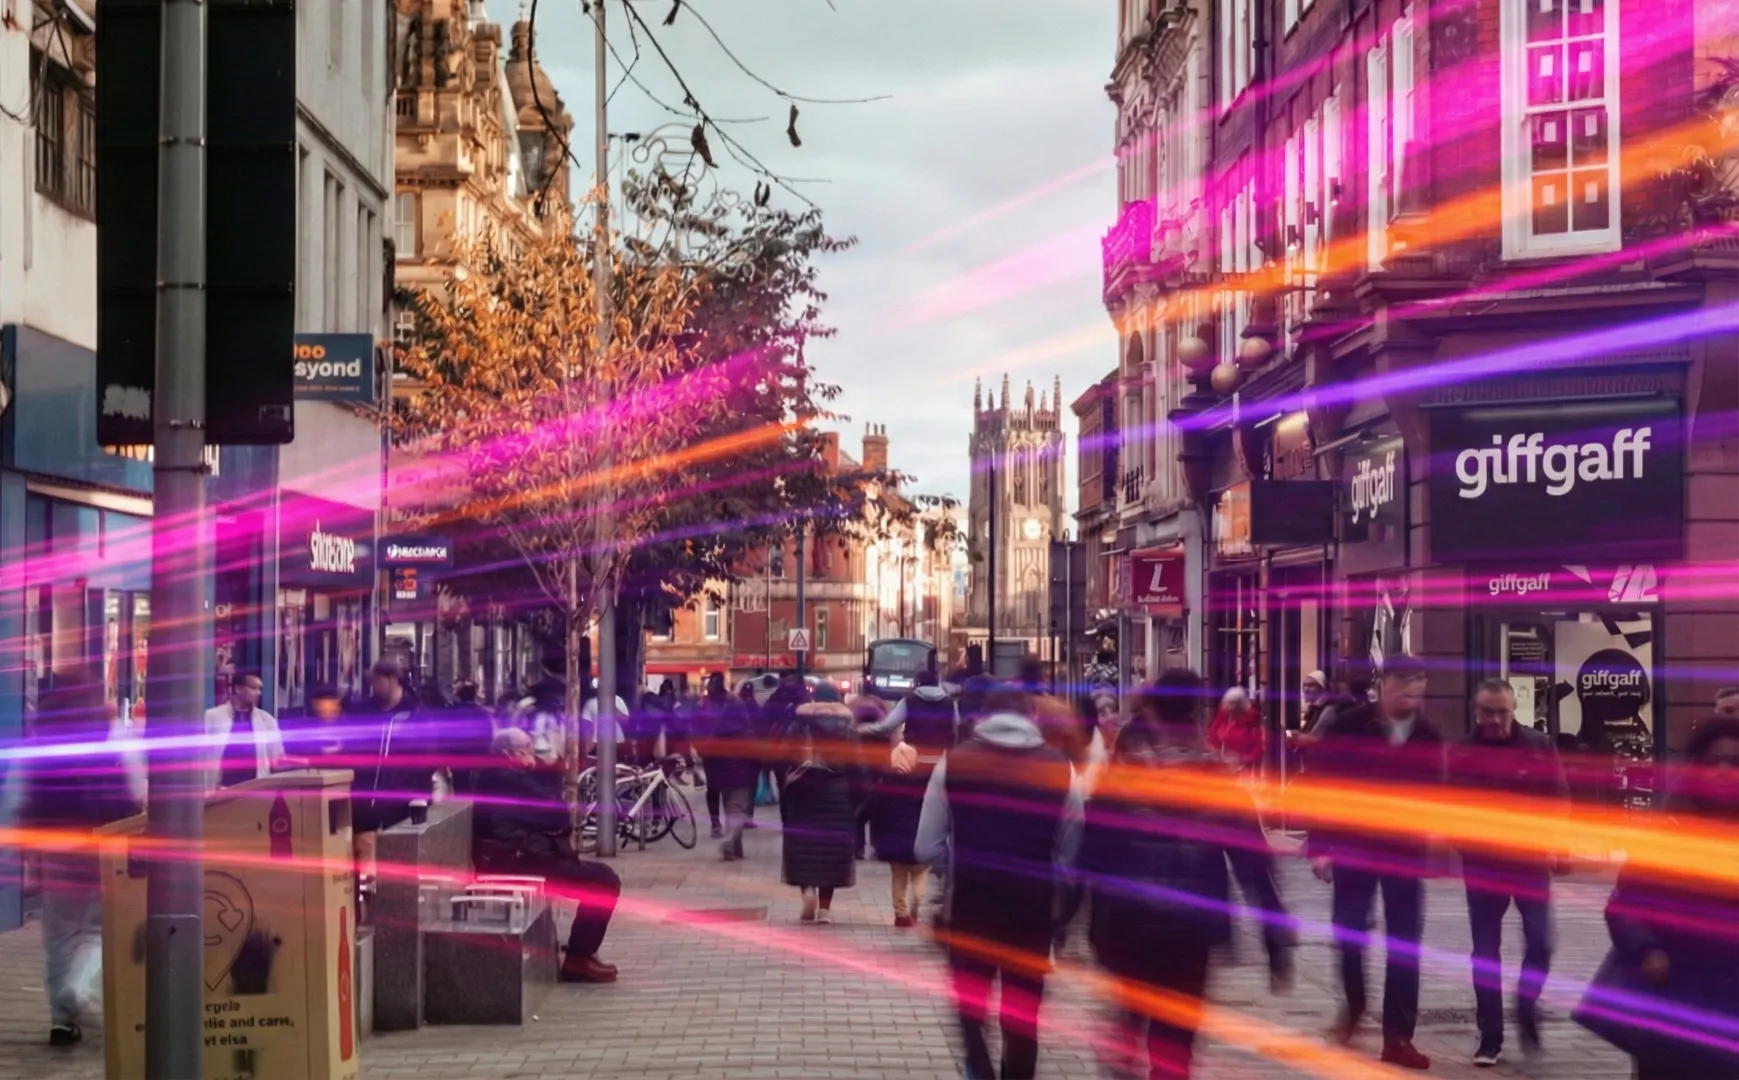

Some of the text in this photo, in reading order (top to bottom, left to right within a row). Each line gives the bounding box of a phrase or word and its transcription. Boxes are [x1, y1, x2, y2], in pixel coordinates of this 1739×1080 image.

[1456, 427, 1651, 498] giffgaff
[1352, 450, 1396, 524] giffgaff
[1489, 573, 1551, 595] giffgaff
[1582, 670, 1642, 690] giffgaff
[230, 1015, 255, 1028] and
